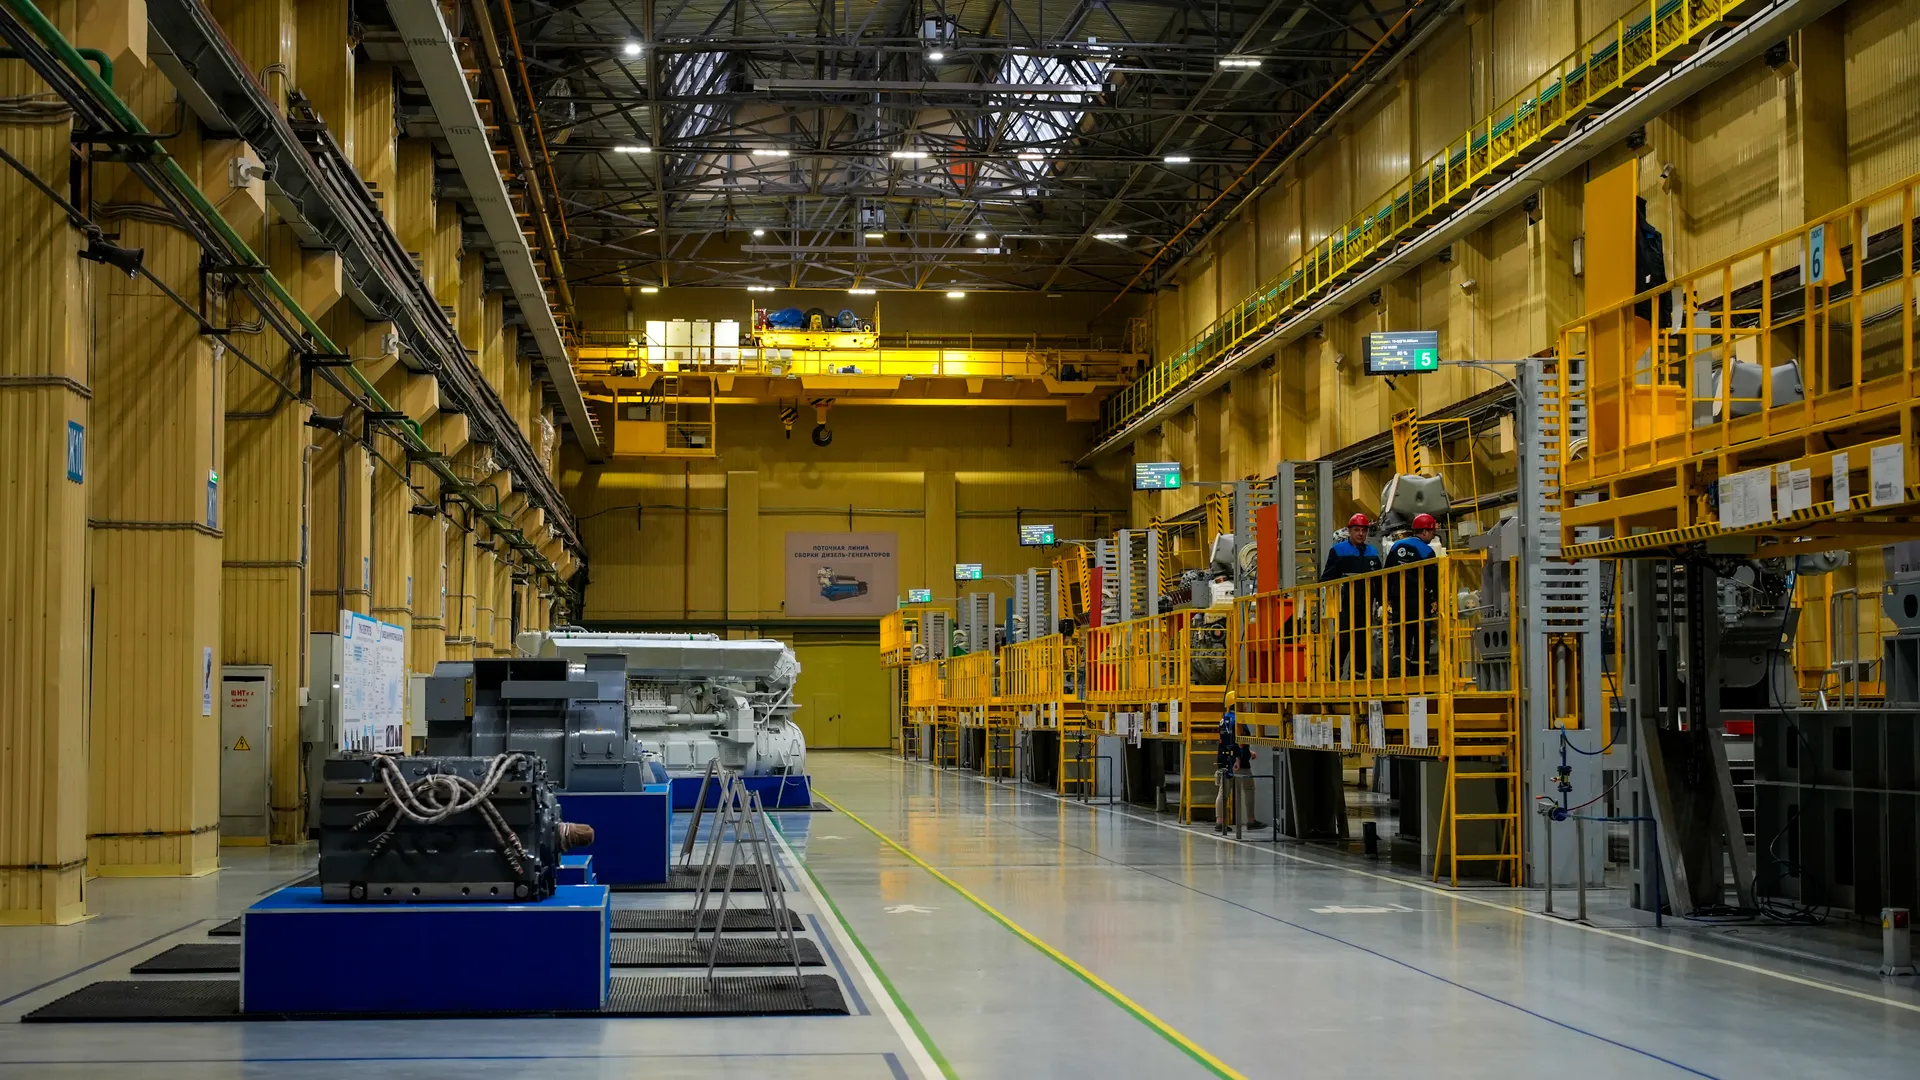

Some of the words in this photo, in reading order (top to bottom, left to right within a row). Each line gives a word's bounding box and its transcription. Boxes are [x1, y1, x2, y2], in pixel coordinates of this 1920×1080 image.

[1812, 246, 1820, 278] 6
[1421, 352, 1431, 366] 5
[68, 427, 83, 476] Ж10
[1169, 475, 1176, 486] 4
[1045, 534, 1051, 543] 3
